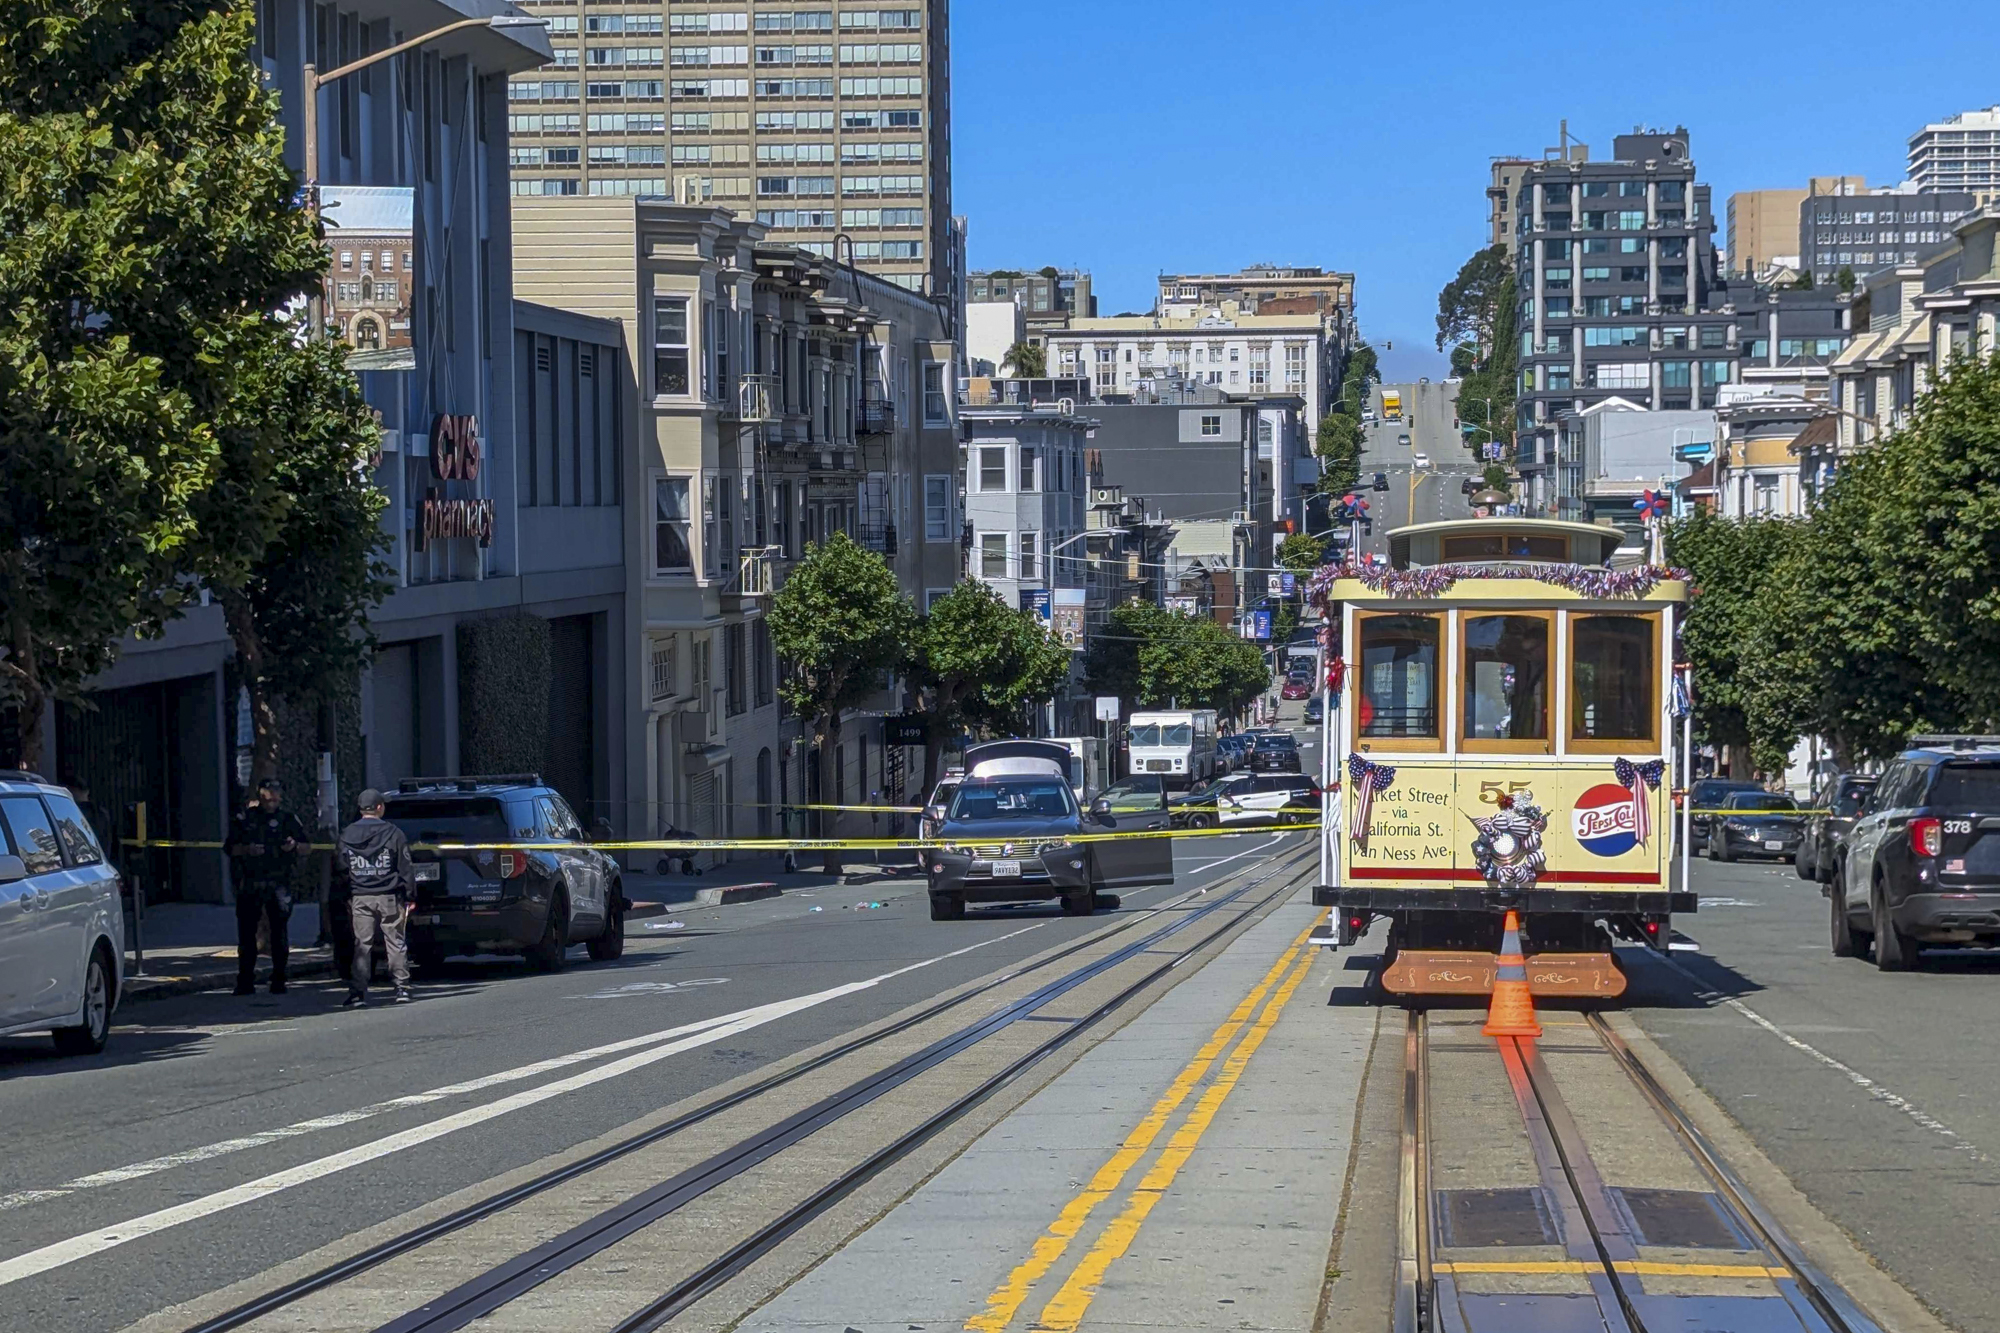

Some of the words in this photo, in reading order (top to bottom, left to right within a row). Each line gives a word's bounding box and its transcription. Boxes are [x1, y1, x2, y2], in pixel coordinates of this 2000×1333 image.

[434, 413, 479, 480] CVS
[421, 487, 494, 552] pharmacy
[899, 728, 921, 737] 1499
[1407, 787, 1449, 806] Street
[1391, 806, 1408, 818] via
[1427, 822, 1444, 837] St.
[1943, 820, 1972, 834] 378
[1353, 841, 1377, 859] Van
[1383, 845, 1416, 861] Ness
[1422, 845, 1452, 860] Ave.
[350, 855, 391, 869] POLCE
